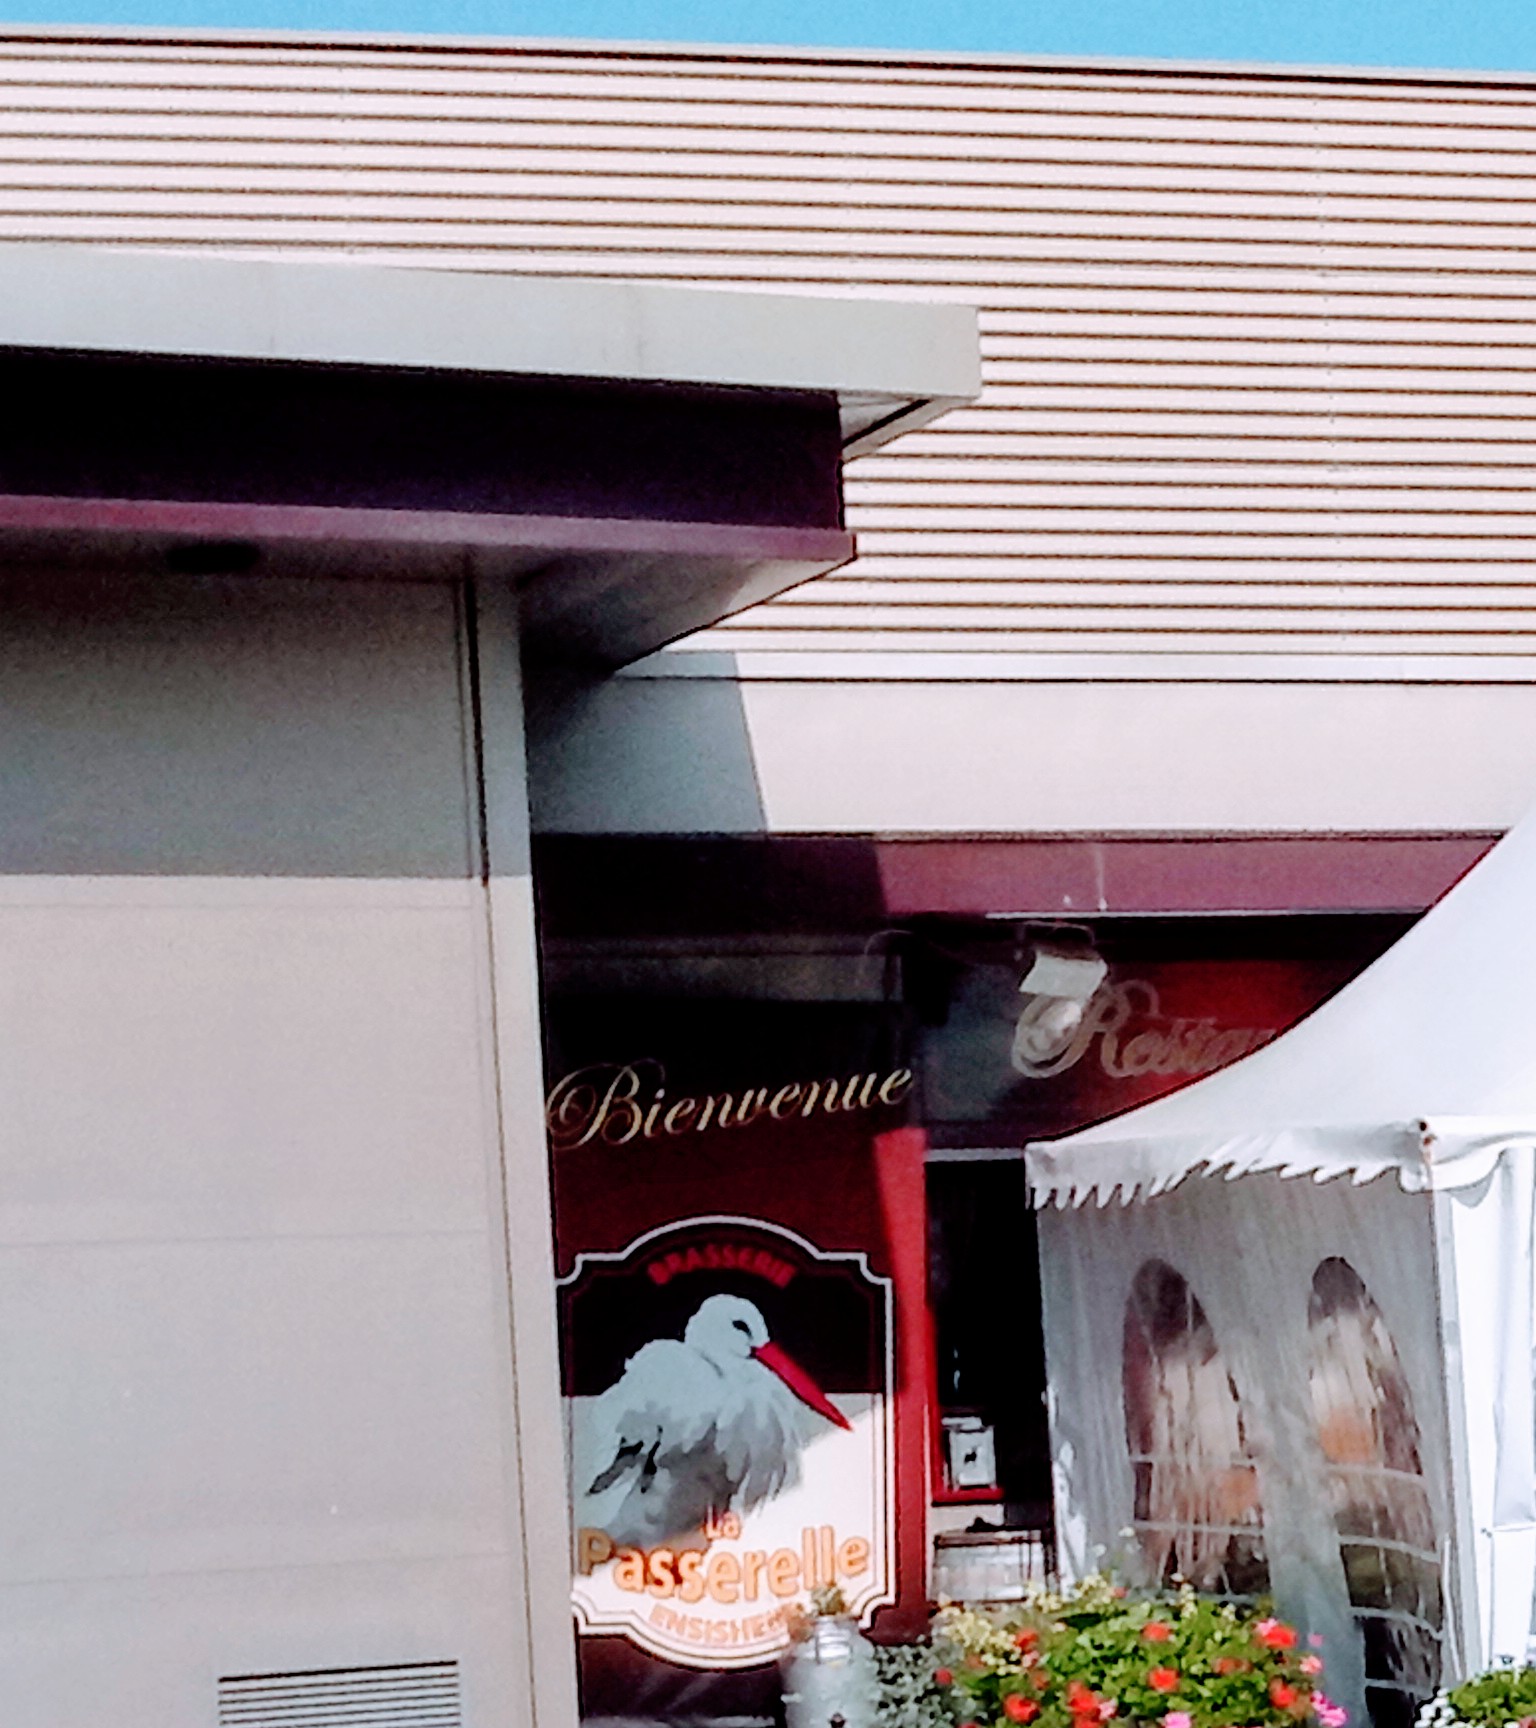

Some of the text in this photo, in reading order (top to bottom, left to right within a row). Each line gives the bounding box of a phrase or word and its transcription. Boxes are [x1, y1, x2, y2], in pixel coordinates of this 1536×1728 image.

[546, 1059, 912, 1150] Bienvenue
[647, 1244, 796, 1288] BRASSERIE
[704, 1506, 740, 1540] La
[578, 1525, 871, 1602] Passerelle
